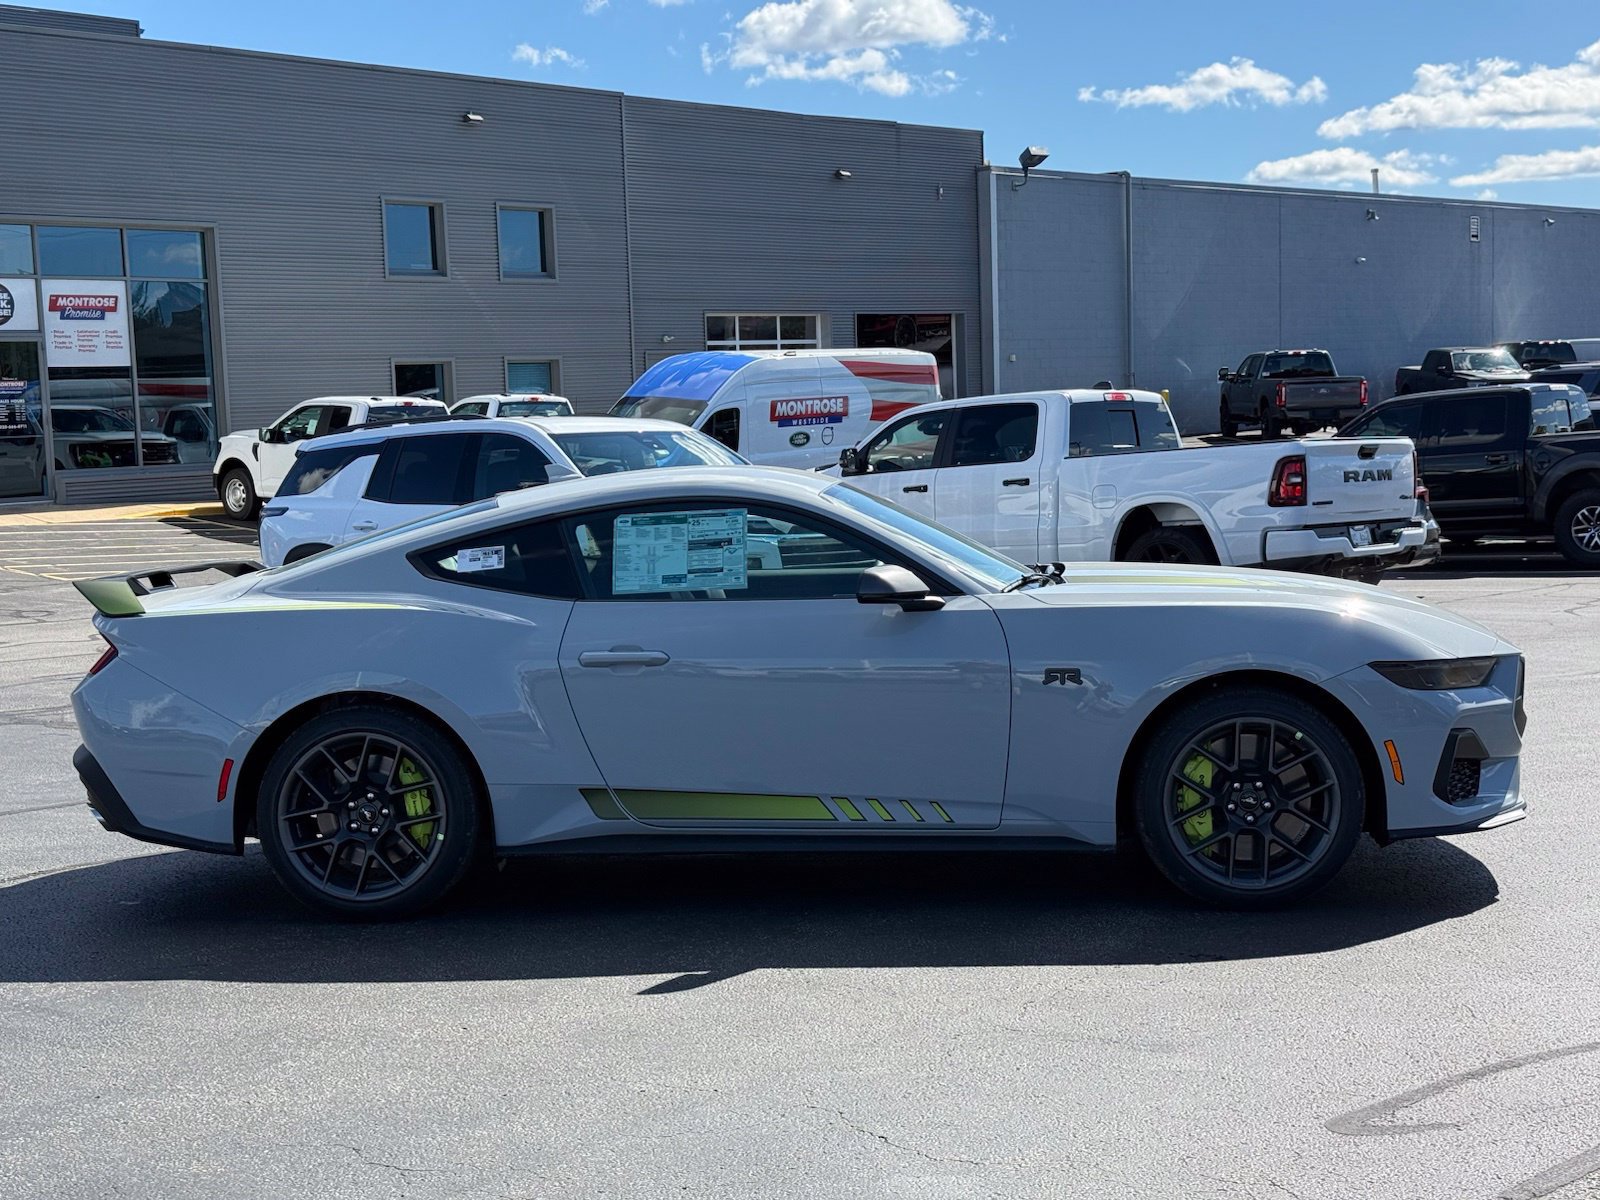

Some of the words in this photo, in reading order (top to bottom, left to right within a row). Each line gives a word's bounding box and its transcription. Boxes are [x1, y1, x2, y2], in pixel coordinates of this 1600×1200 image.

[57, 297, 116, 306] MONTROSE
[64, 306, 102, 318] Promise
[775, 398, 844, 417] MONTROSE
[792, 417, 829, 426] WESTSIDE
[1343, 469, 1393, 483] RAM
